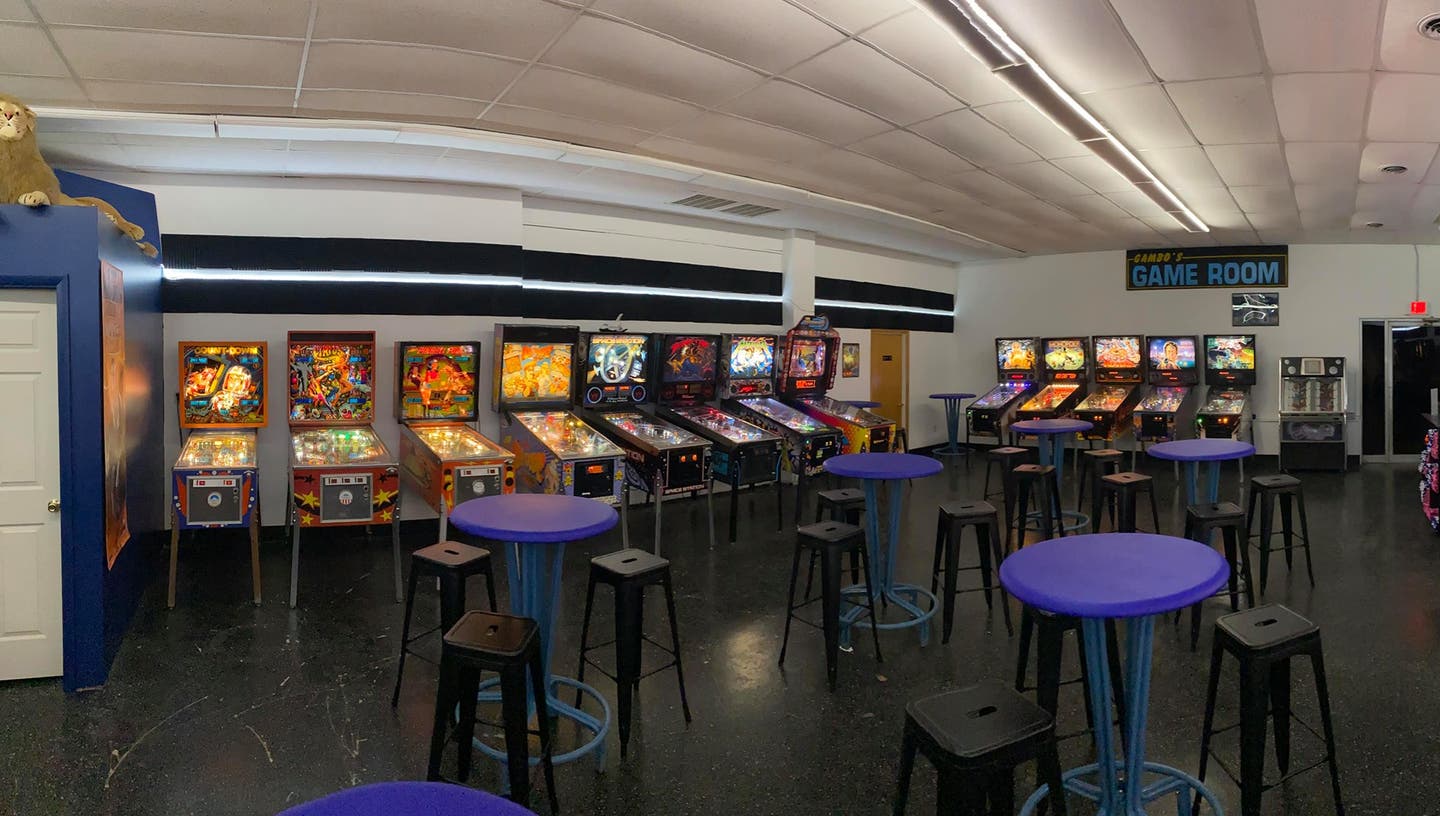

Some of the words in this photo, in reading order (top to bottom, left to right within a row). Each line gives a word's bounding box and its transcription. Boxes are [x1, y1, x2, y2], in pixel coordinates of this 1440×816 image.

[1134, 252, 1184, 264] GAMBO'S
[1132, 263, 1199, 287] GAME
[1208, 261, 1279, 285] ROOM
